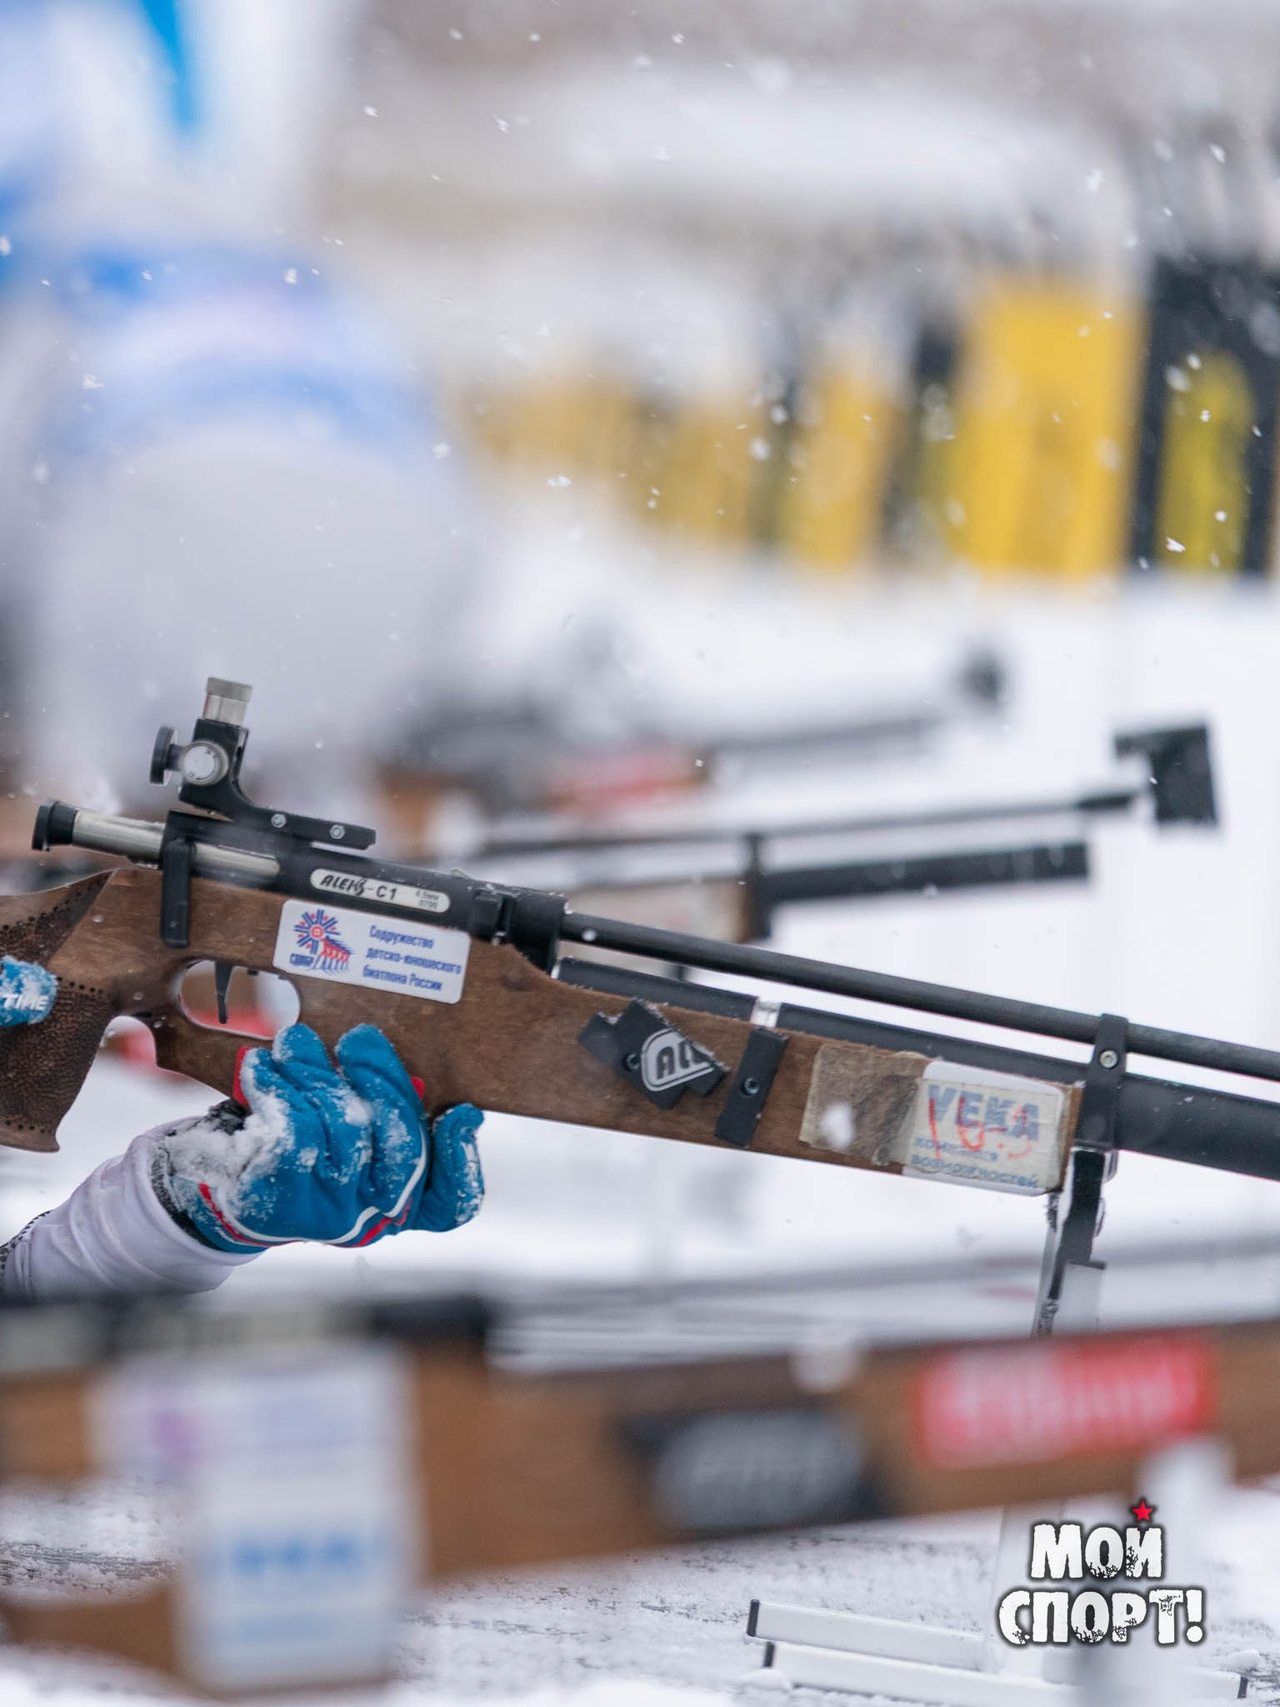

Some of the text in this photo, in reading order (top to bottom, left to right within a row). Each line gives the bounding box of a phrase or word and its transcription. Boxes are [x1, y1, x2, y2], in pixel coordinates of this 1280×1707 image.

[369, 924, 435, 949] Содружество
[365, 946, 462, 975] детско-юношеского
[362, 964, 443, 992] биатлона России
[925, 1083, 1041, 1141] VEKA
